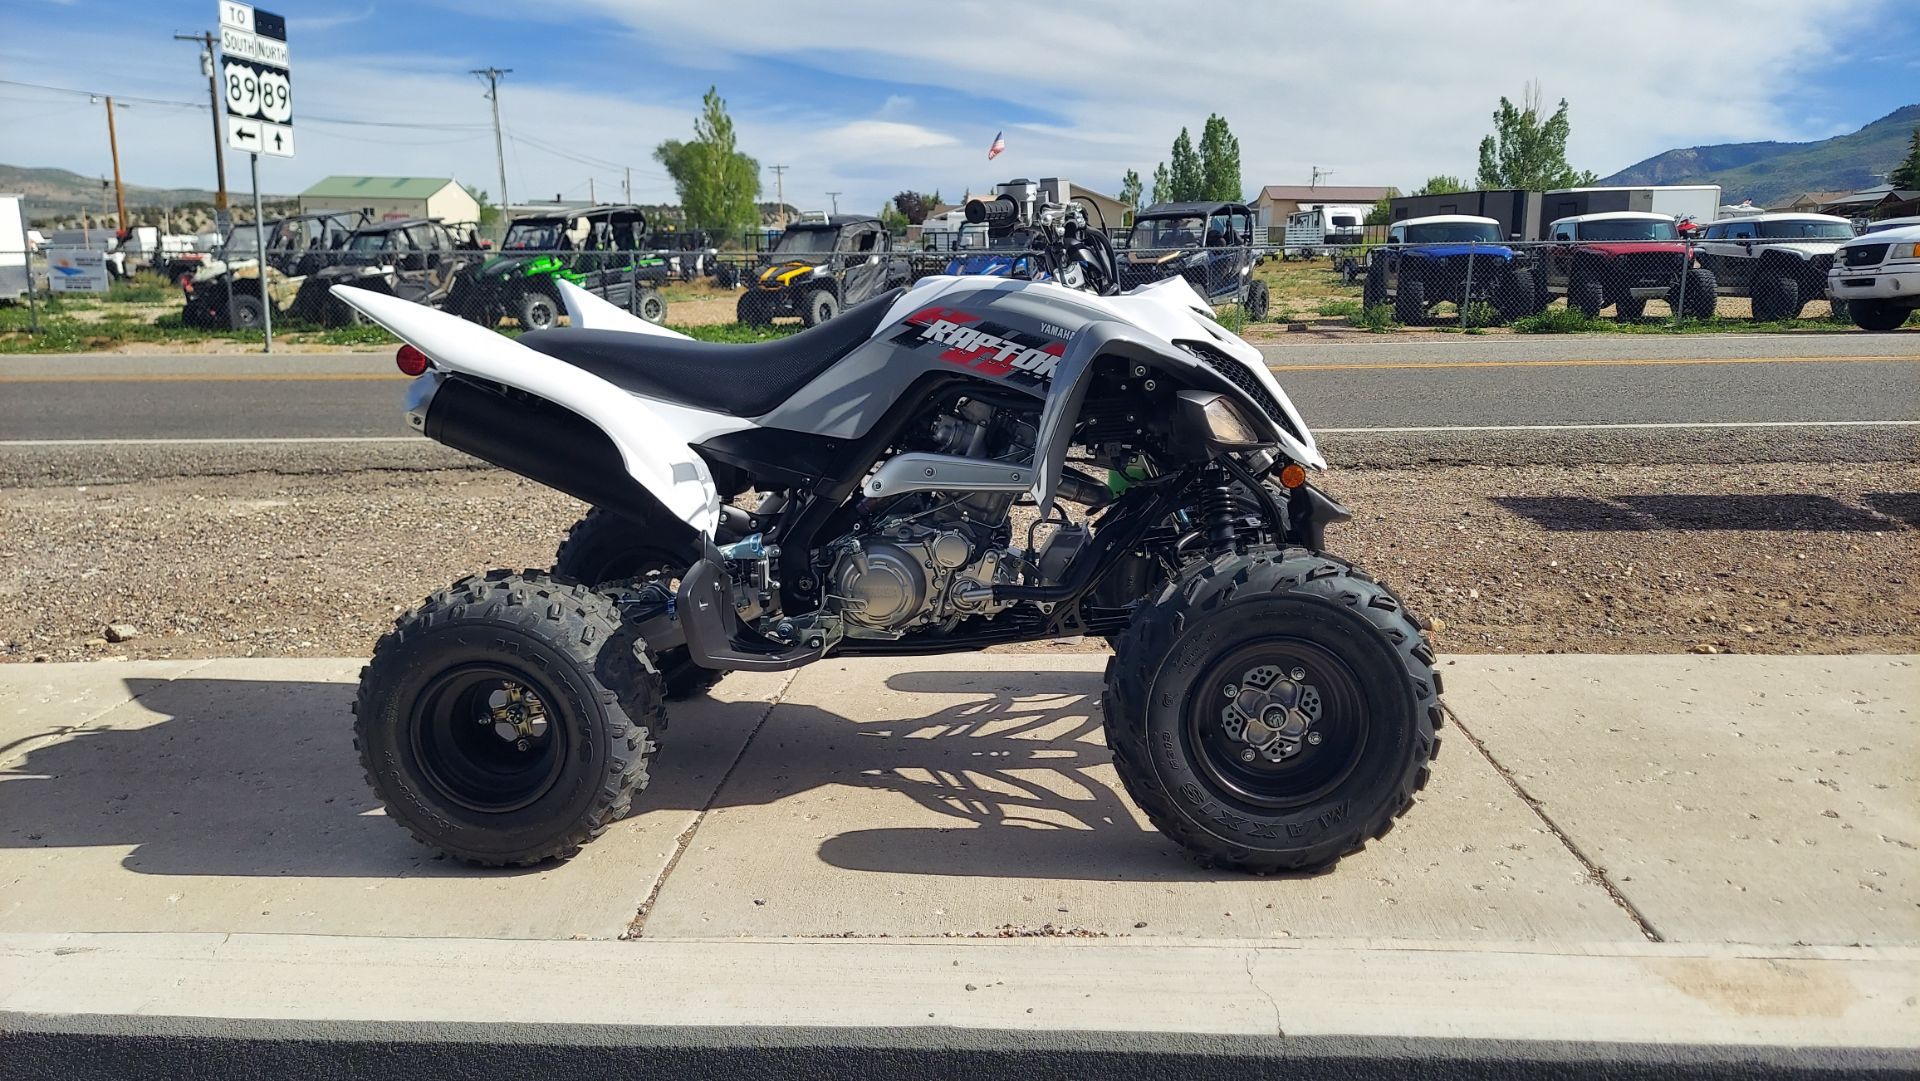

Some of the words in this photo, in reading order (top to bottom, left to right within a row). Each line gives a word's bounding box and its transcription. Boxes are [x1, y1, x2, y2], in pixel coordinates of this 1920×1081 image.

[230, 7, 245, 24] TO
[224, 31, 255, 54] SOUTH
[257, 41, 287, 63] NORTH
[230, 74, 255, 103] 89
[263, 82, 287, 109] 89
